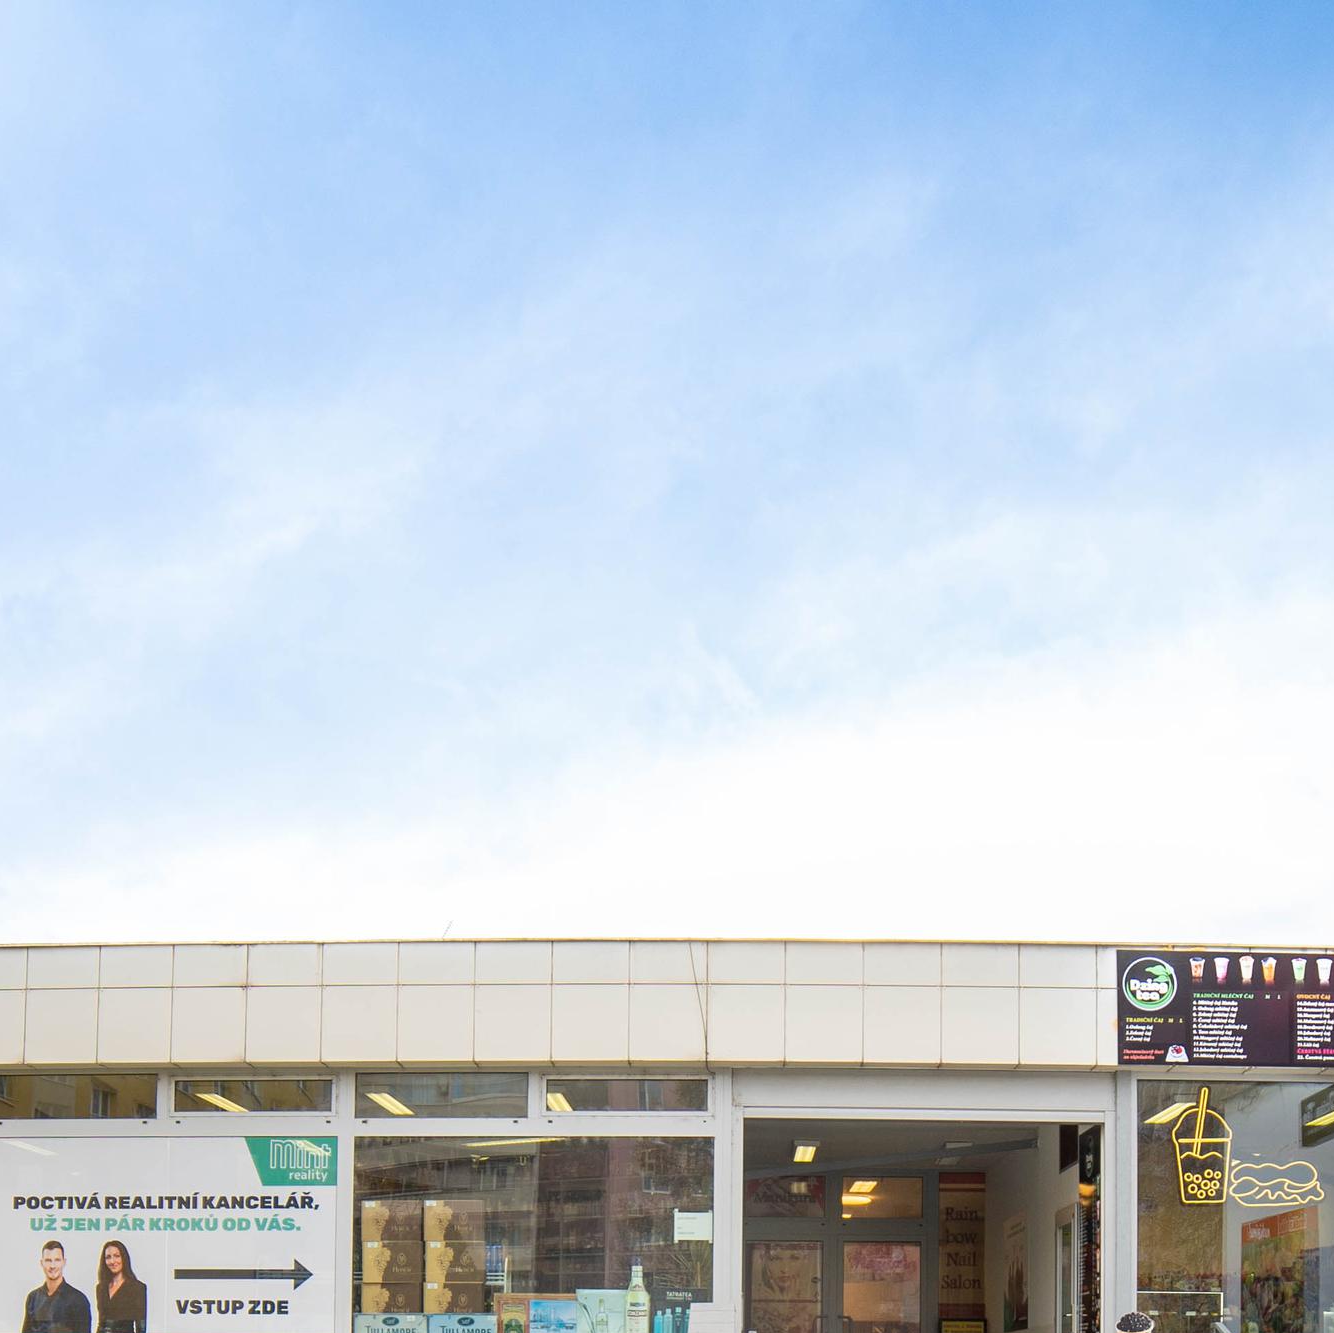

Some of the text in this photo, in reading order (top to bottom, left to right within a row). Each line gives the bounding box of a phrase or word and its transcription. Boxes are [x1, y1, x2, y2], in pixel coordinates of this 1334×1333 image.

[269, 1139, 332, 1169] mint
[289, 1169, 328, 1183] reality
[13, 1192, 320, 1211] POCTIVÁ REALITNÍ KANCELÁŘ,
[30, 1213, 302, 1232] UŽ JEN PÁR KROKŮ OD VÁS.
[945, 1252, 978, 1267] Nail
[941, 1274, 982, 1290] Salon
[176, 1299, 289, 1316] VSTUP ZDE
